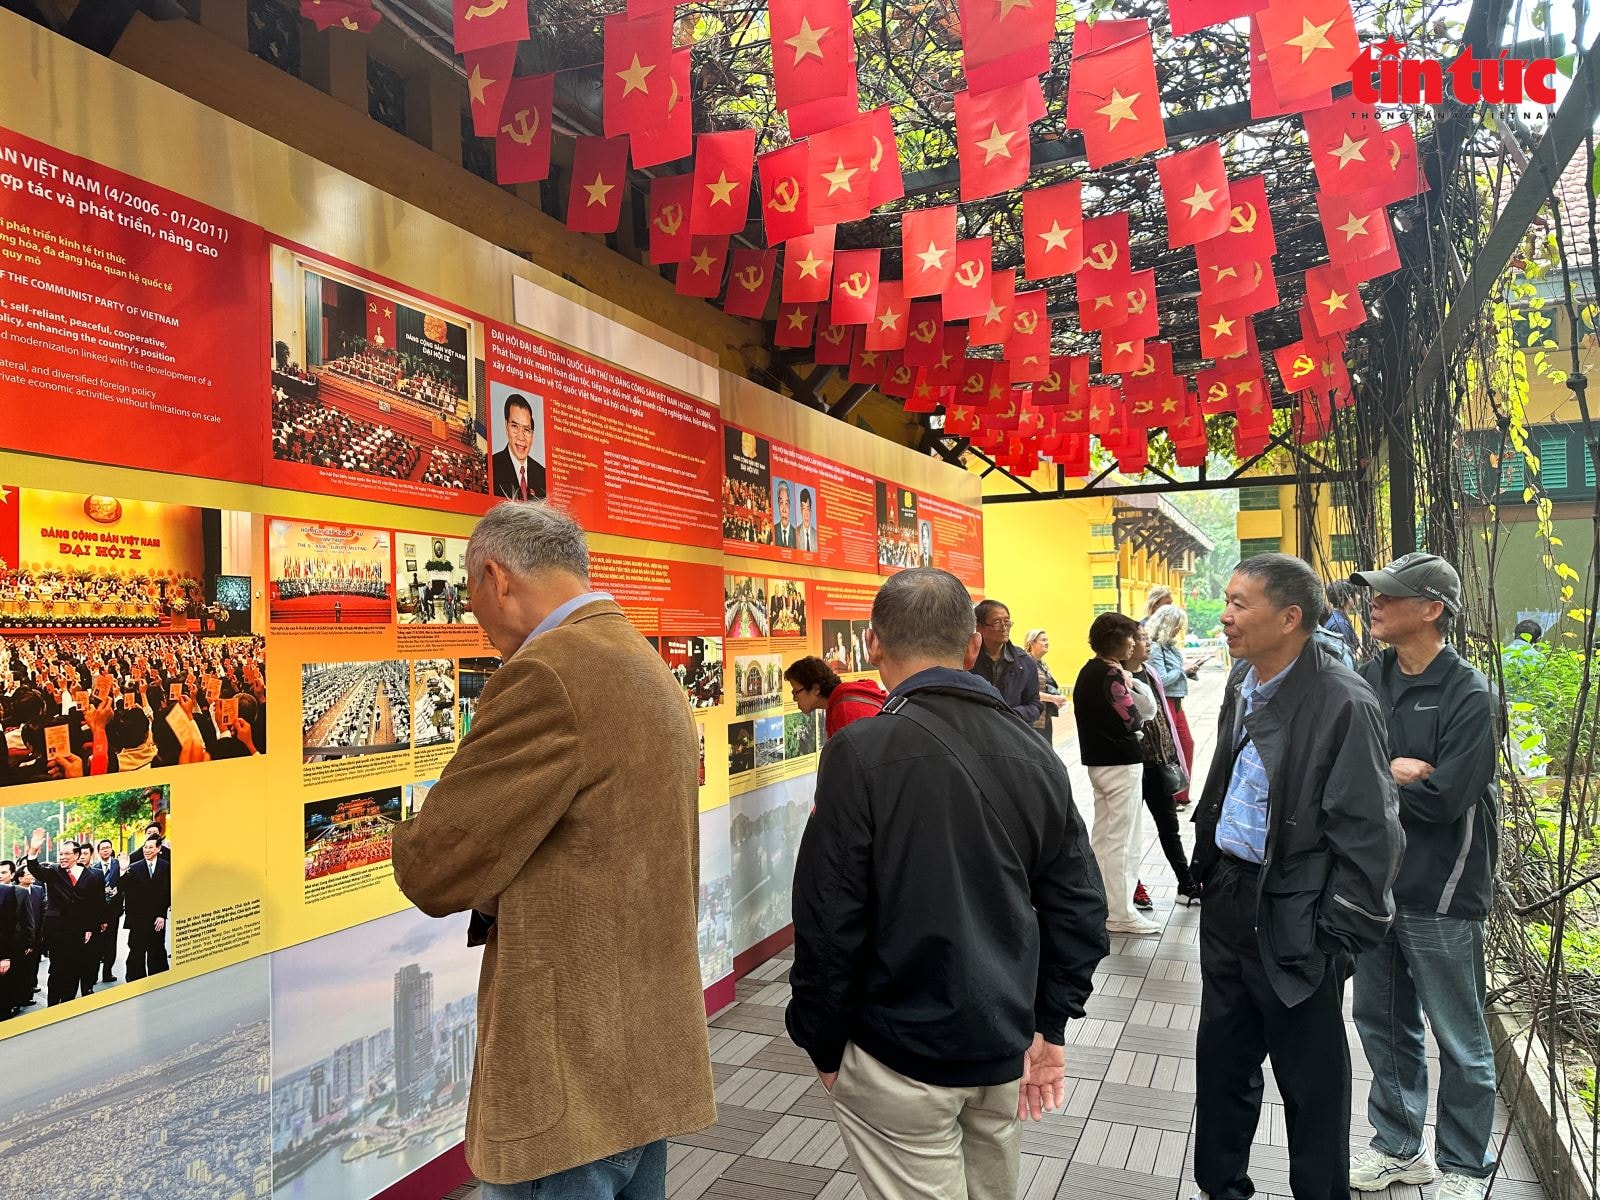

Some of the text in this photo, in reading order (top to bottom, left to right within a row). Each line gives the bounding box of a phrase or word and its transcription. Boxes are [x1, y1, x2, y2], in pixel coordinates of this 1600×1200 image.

[20, 153, 59, 179] VIỆT
[62, 169, 101, 195] NAM
[104, 185, 160, 216] (4/2006
[170, 210, 229, 244] 01/2011)
[27, 180, 53, 200] tác
[56, 192, 75, 208] và
[79, 200, 115, 222] phát
[117, 212, 156, 238] triển,
[159, 229, 193, 252] nâng
[195, 242, 219, 258] cao
[7, 271, 29, 286] THE
[30, 278, 94, 303] COMMUNIST
[95, 296, 125, 311] PARTY
[126, 305, 138, 315] OF
[140, 308, 180, 327] VIETNAM
[10, 302, 68, 325] self-reliant,
[69, 317, 113, 336] peaceful,
[113, 329, 168, 350] cooperative,
[26, 321, 79, 342] enhancing
[81, 333, 96, 344] the
[98, 338, 139, 354] country's
[141, 348, 176, 363] position
[10, 334, 79, 356] modernization
[81, 348, 108, 363] linked
[109, 356, 129, 367] with
[130, 361, 144, 371] the
[145, 364, 196, 383] development
[491, 329, 505, 344] ĐẠI
[505, 334, 519, 348] HỘI
[519, 340, 532, 354] ĐẠI
[532, 344, 548, 358] BIỂU
[548, 350, 566, 365] TOÀN
[566, 357, 584, 372] QUỐC
[615, 374, 631, 389] ĐẢNG
[41, 526, 161, 548] ĐẢNG CỘNG SẢN VIỆT NAM
[59, 542, 142, 561] ĐẠI HỘI X
